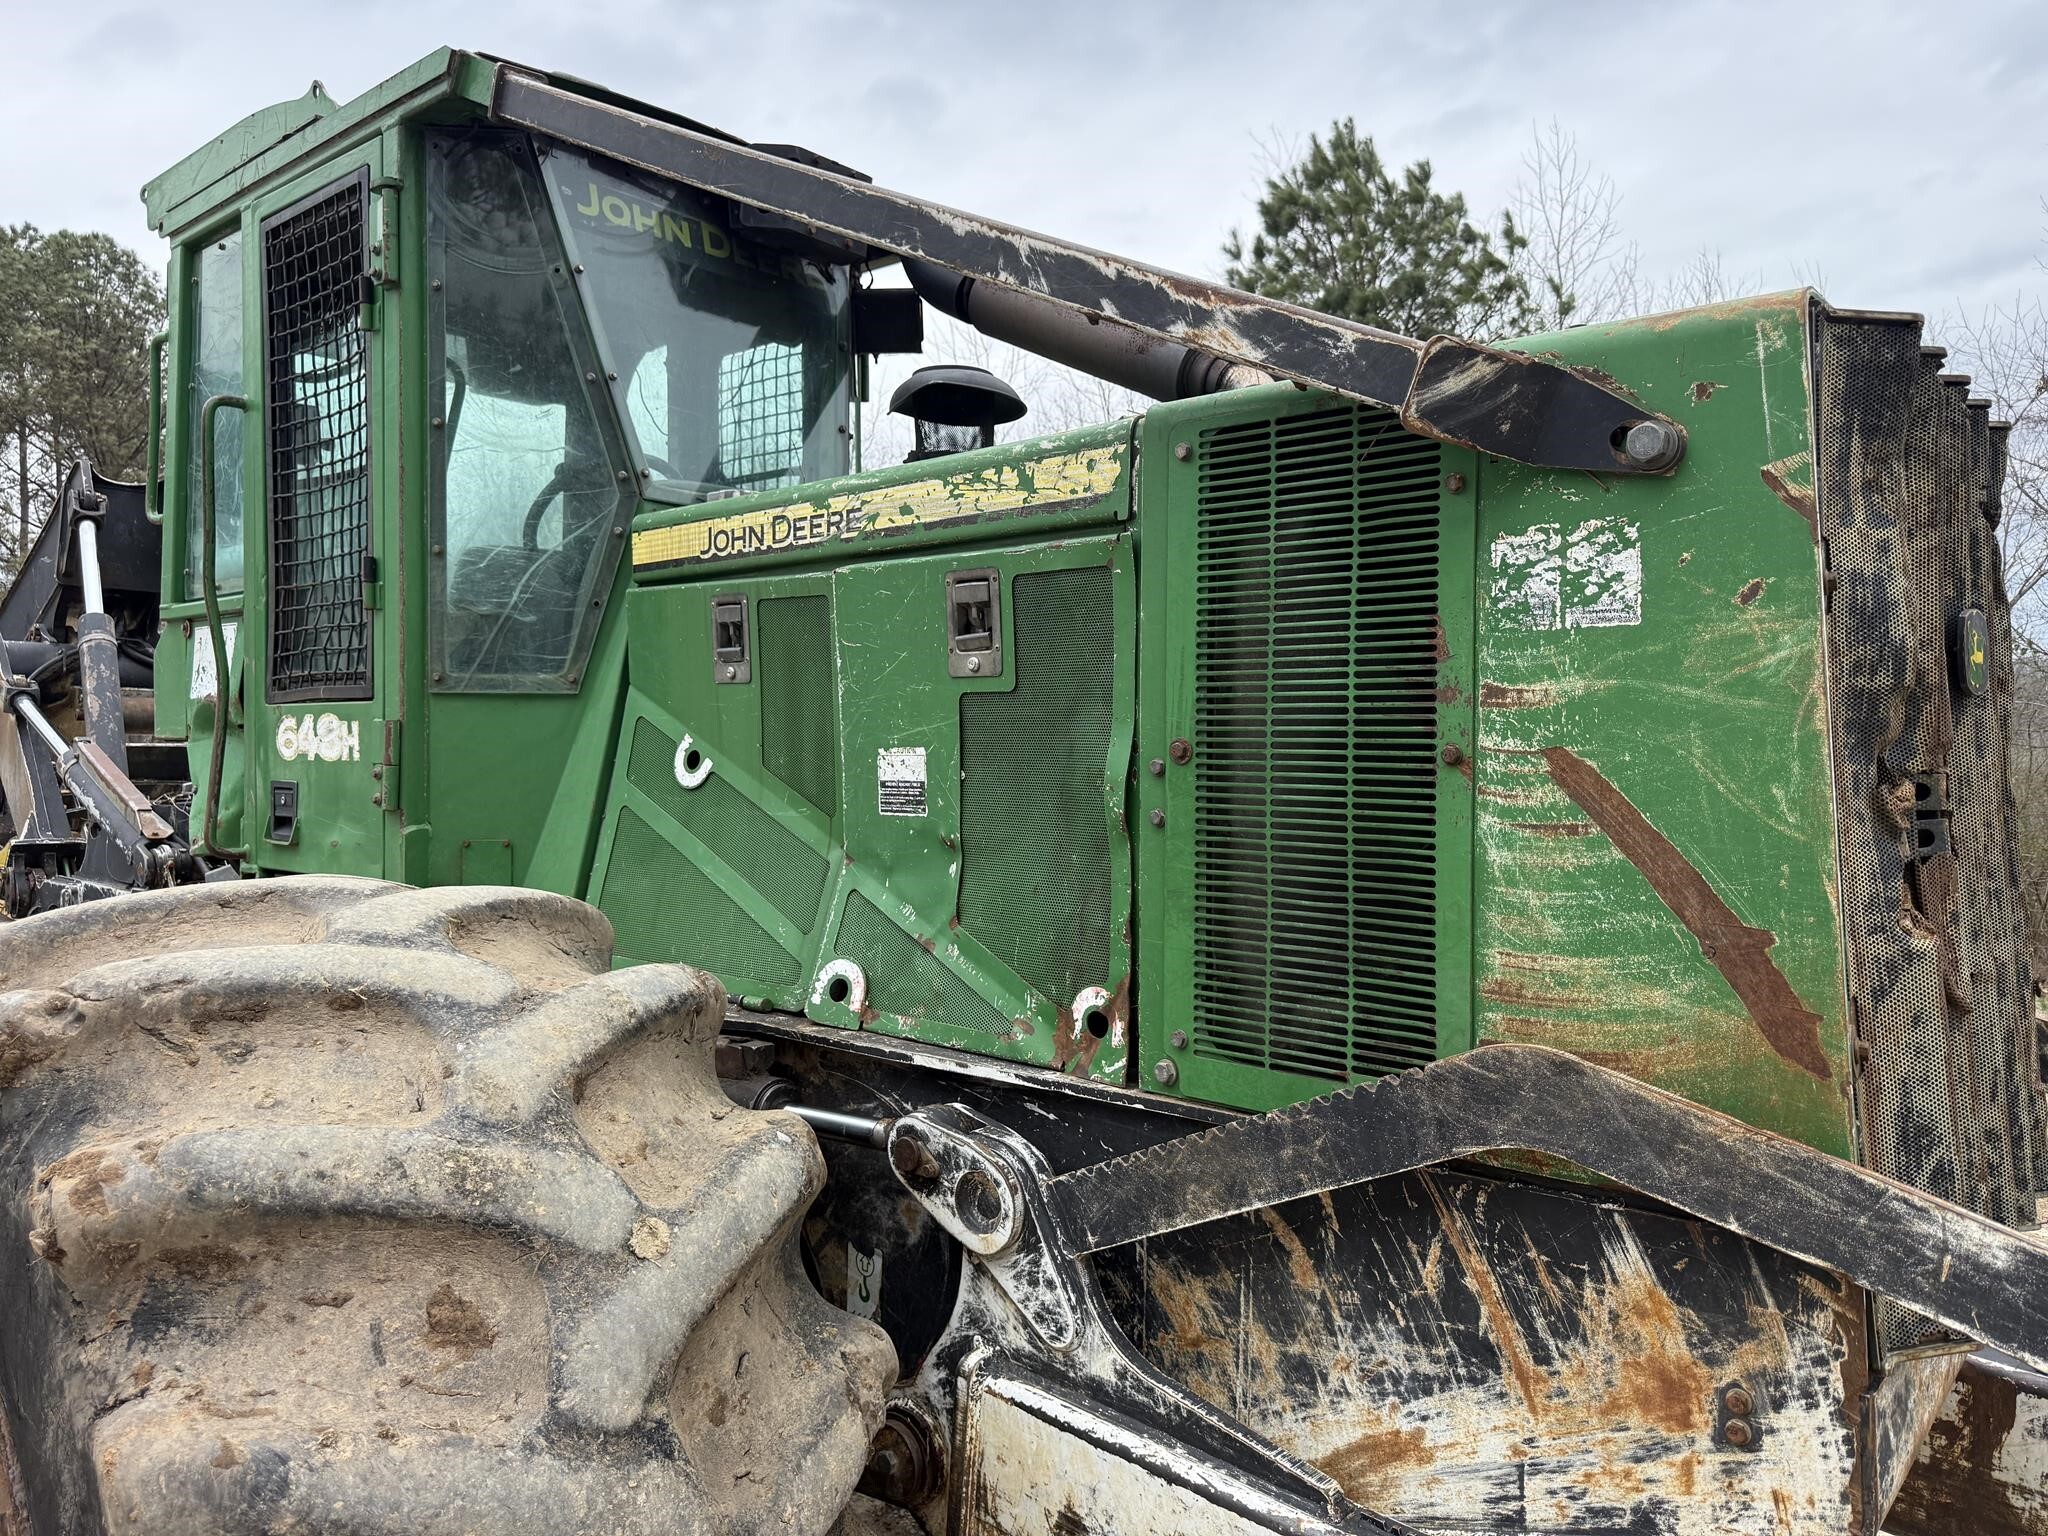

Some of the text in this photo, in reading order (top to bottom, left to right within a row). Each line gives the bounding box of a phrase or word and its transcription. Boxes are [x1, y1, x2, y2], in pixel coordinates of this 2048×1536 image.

[576, 183, 692, 248] JOHN
[700, 508, 864, 557] JOHN DEERE
